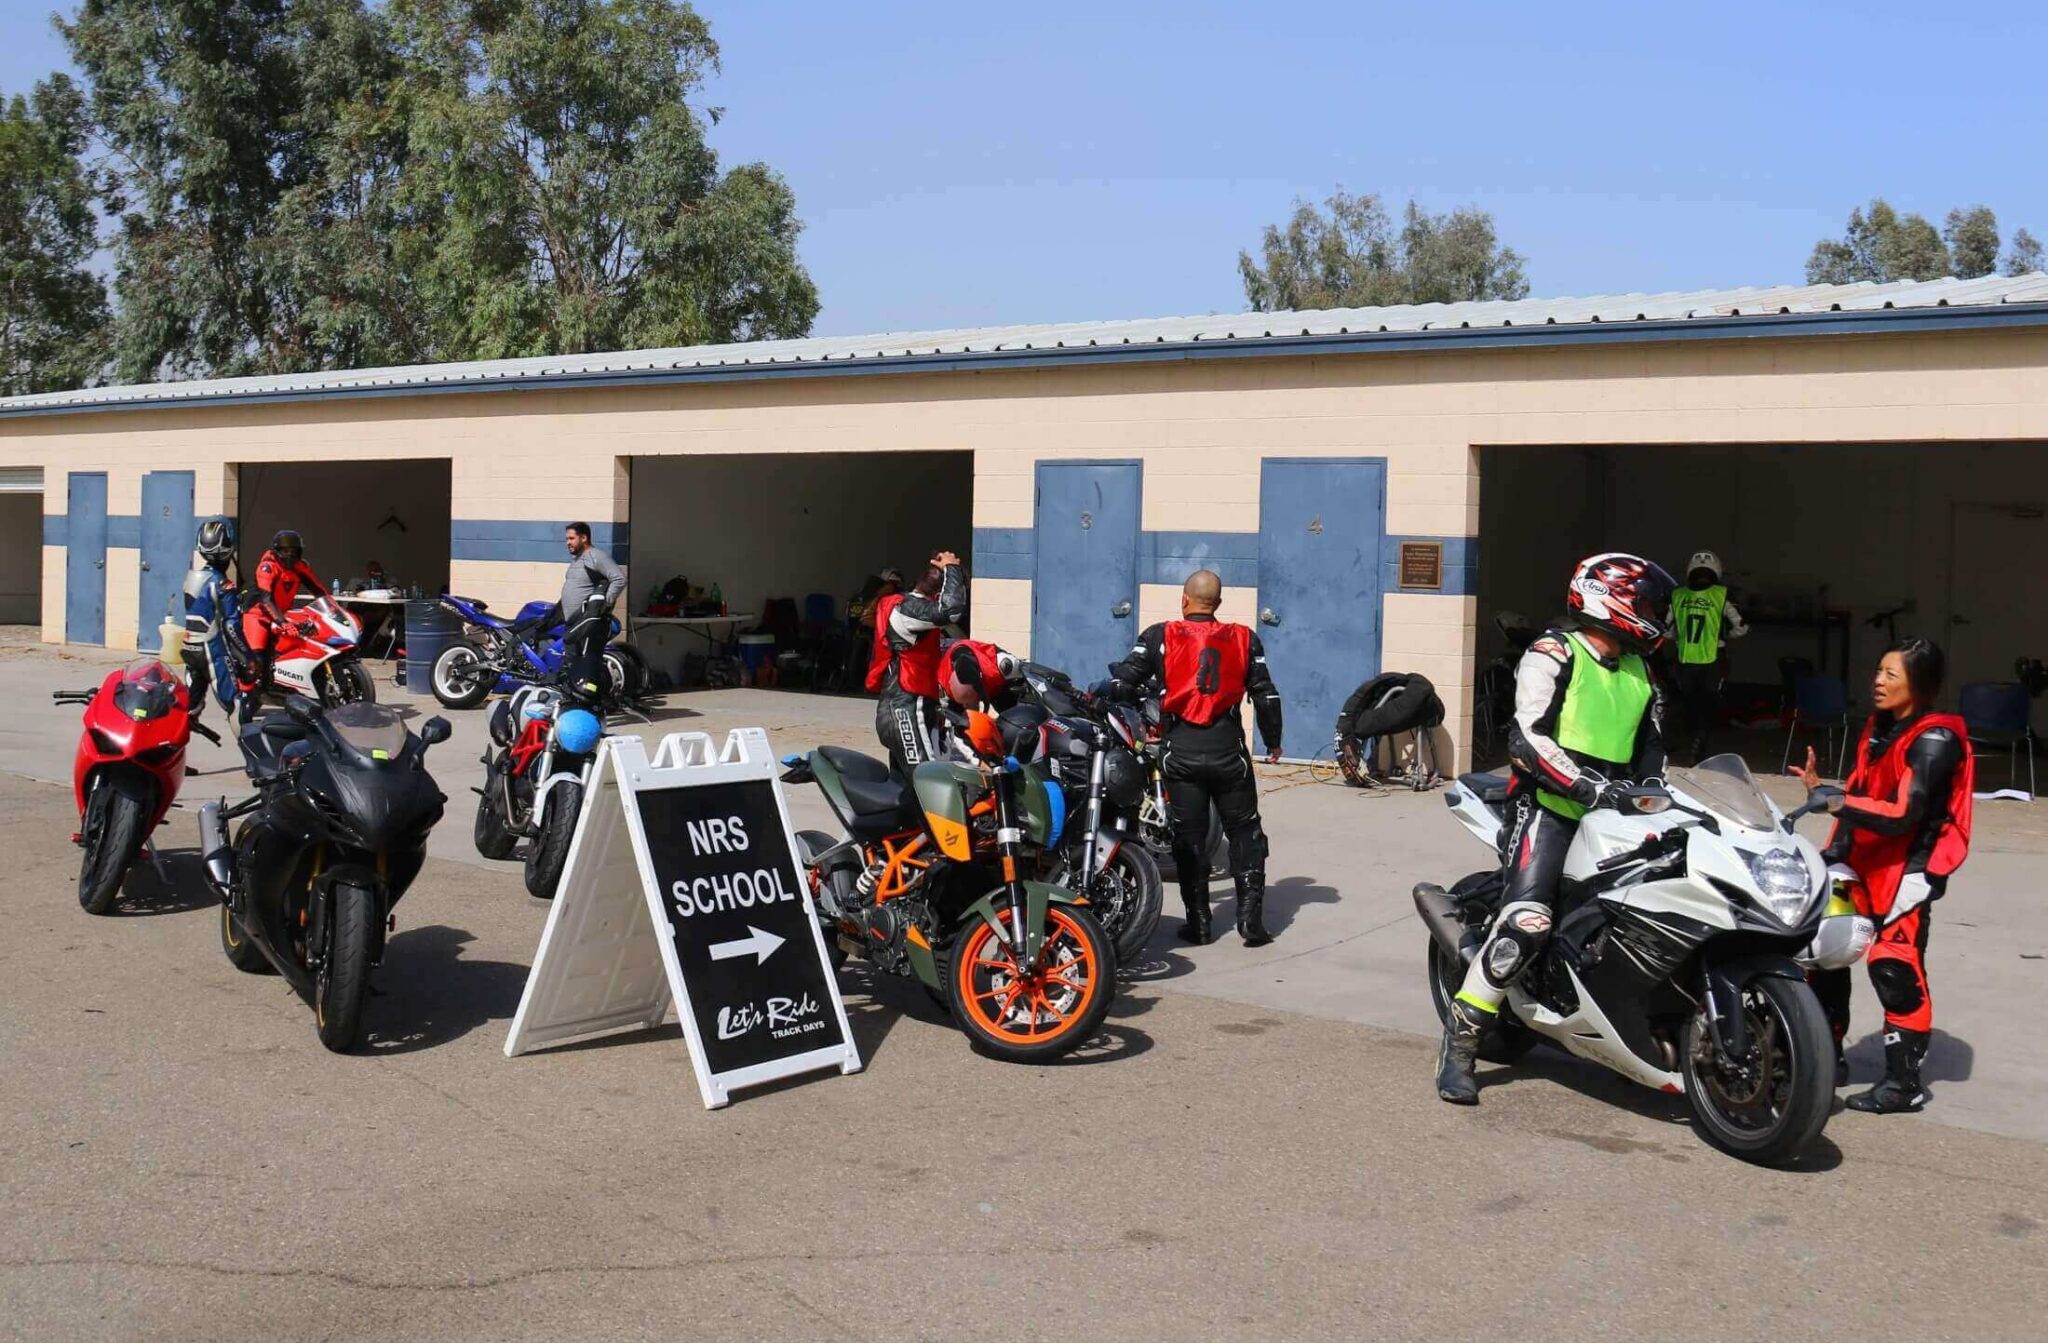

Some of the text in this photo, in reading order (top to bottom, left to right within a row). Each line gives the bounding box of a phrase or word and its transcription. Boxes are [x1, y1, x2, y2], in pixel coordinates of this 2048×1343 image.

[163, 505, 170, 517] 2
[1080, 511, 1092, 530] 3
[1307, 512, 1323, 536] 4
[1588, 581, 1604, 592] Arai
[1686, 614, 1706, 644] 17
[277, 667, 304, 681] DUCATI
[1197, 646, 1221, 695] 8
[895, 708, 919, 764] SEDICI
[686, 815, 749, 856] NRS
[672, 867, 795, 917] SCHOOL
[717, 991, 820, 1040] Let's Ride
[771, 1020, 825, 1039] TRACK DAYS
